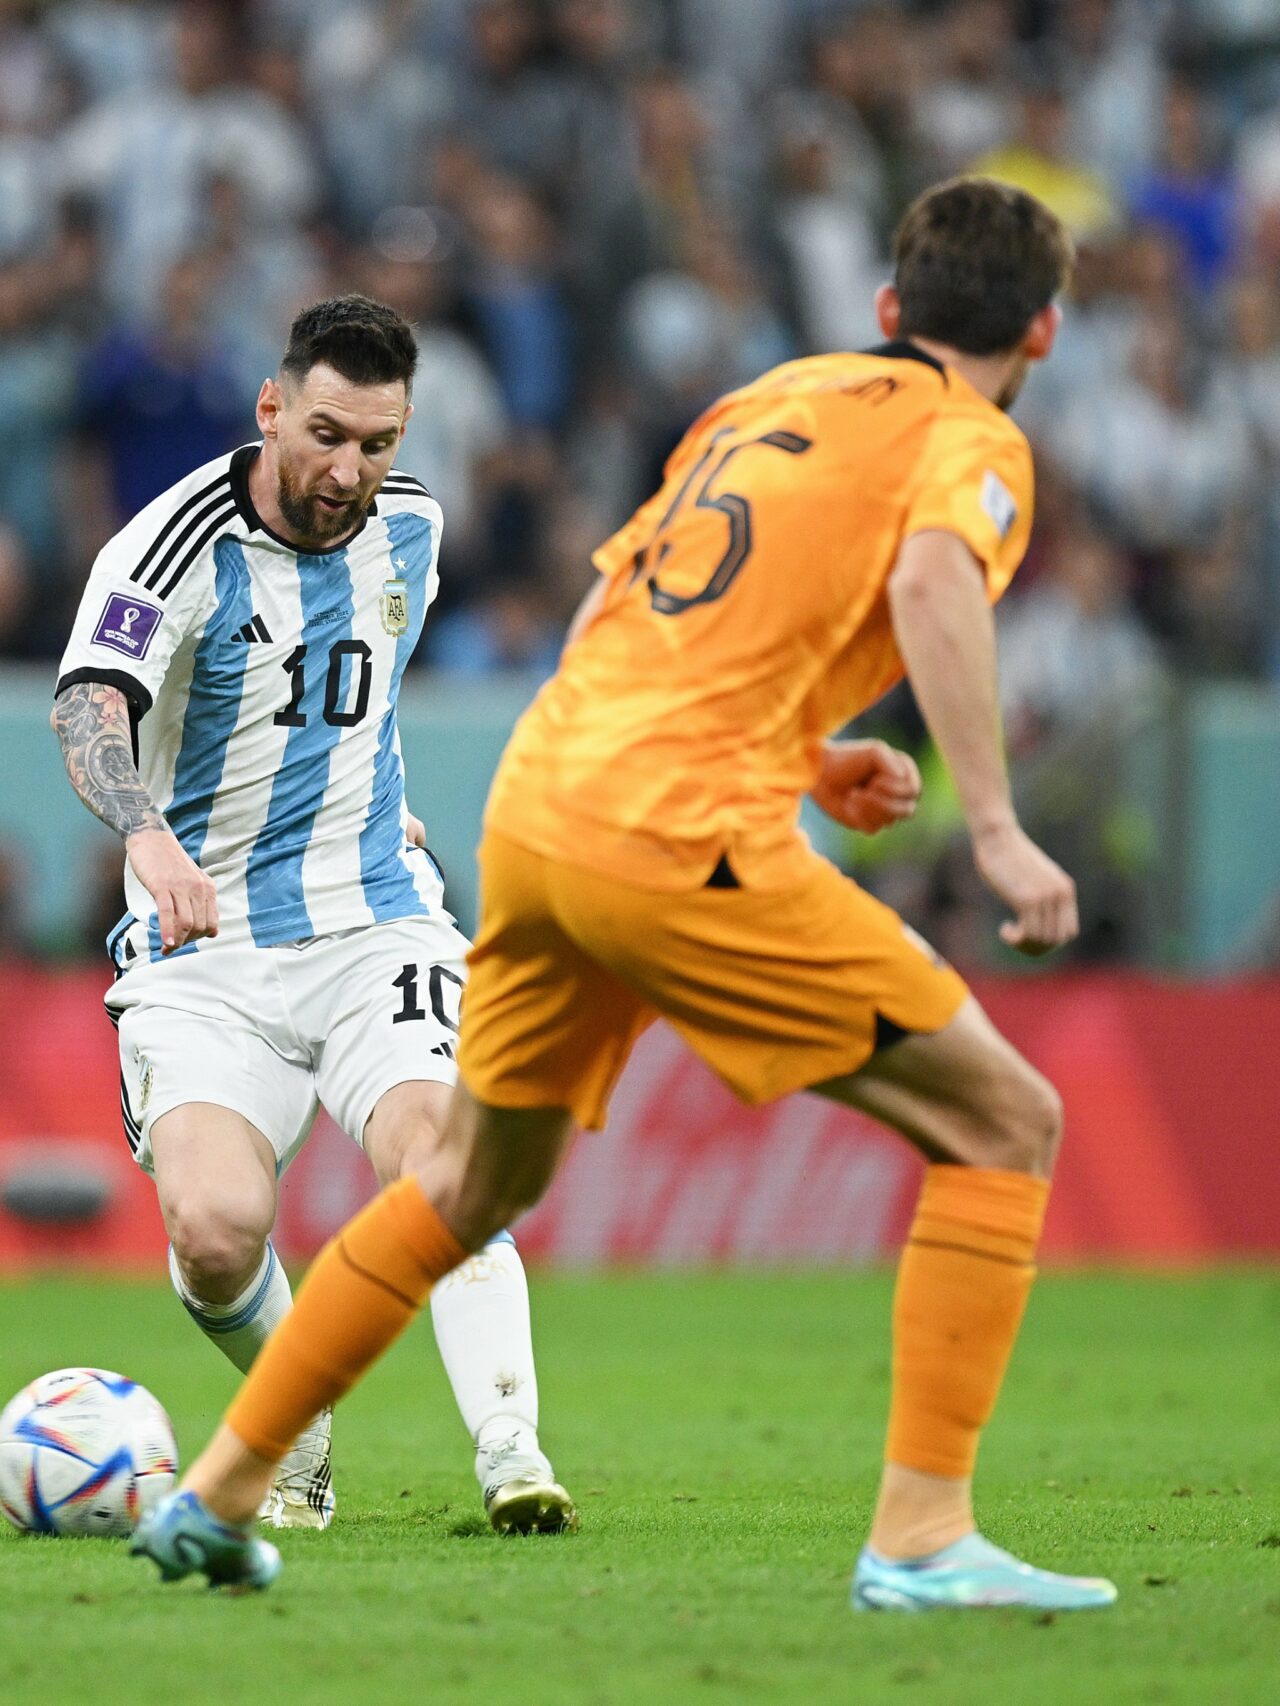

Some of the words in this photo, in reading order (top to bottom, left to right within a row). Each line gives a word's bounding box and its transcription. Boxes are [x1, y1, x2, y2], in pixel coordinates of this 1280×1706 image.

[388, 594, 405, 622] AFA
[273, 640, 373, 728] 10
[391, 963, 467, 1036] 10
